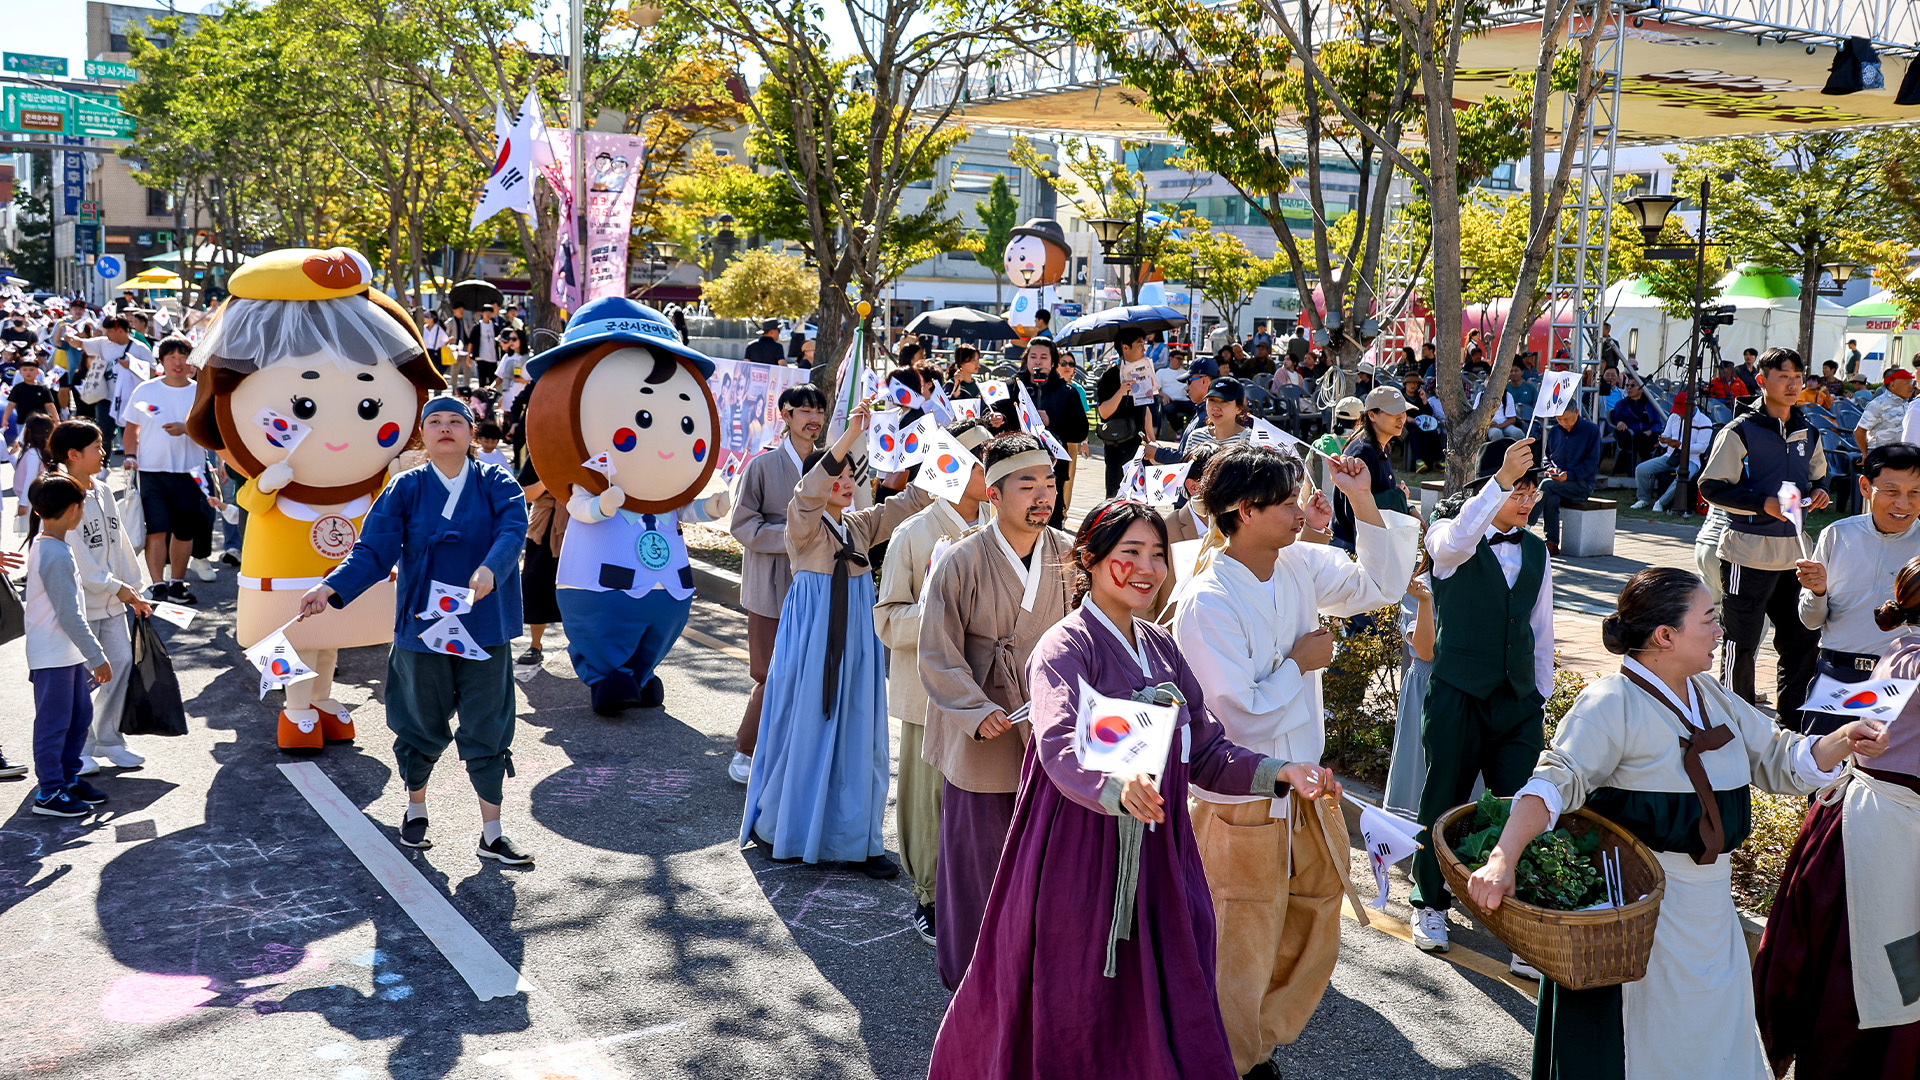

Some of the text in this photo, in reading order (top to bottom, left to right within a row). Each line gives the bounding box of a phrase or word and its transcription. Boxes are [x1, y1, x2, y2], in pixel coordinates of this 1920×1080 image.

[86, 63, 136, 79] 중앙사거리
[20, 92, 67, 105] 국립군산대학교
[605, 321, 677, 339] 군산시간여행
[321, 549, 349, 557] MODERN
